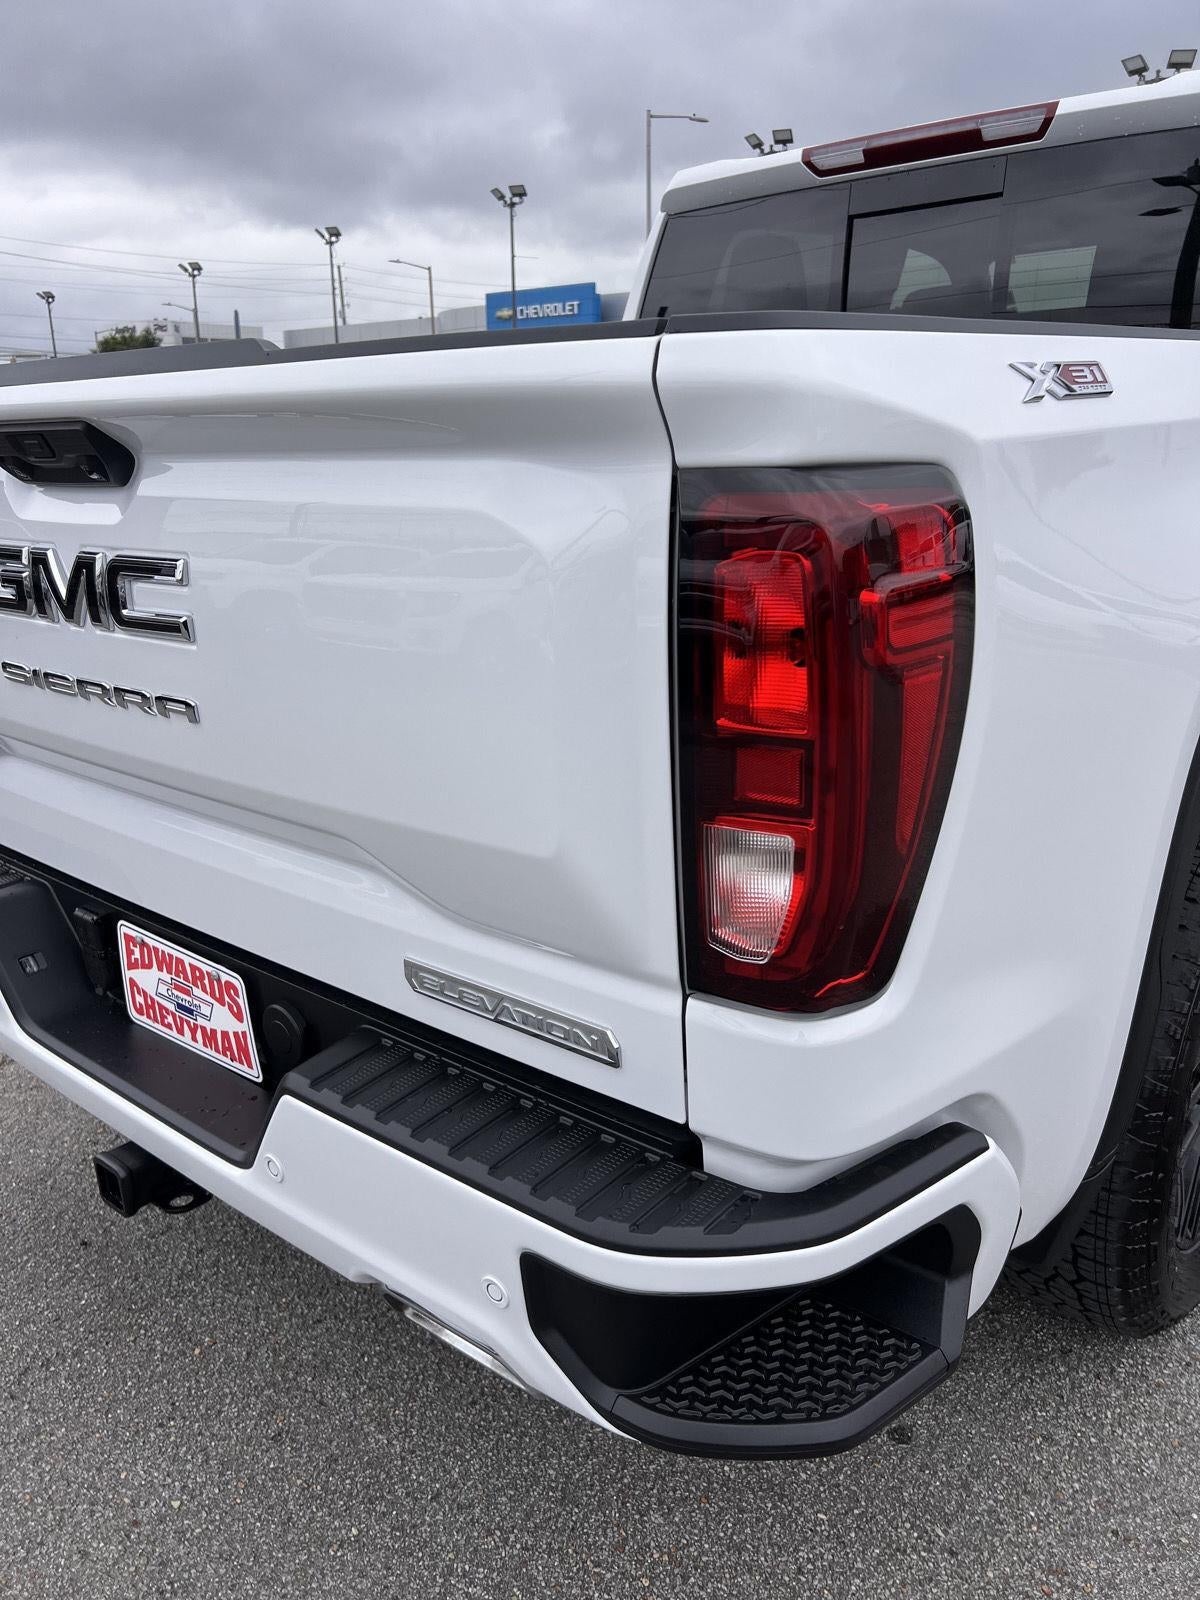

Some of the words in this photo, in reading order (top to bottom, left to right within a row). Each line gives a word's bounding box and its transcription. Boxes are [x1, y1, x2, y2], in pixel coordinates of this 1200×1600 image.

[517, 301, 580, 319] CHEVROLET
[1, 660, 200, 724] SIERRA
[123, 932, 244, 1024] EDWARDS
[166, 988, 202, 1012] Chevrolet
[417, 972, 601, 1049] ELEVATION
[130, 976, 254, 1070] CHEVYMAN
